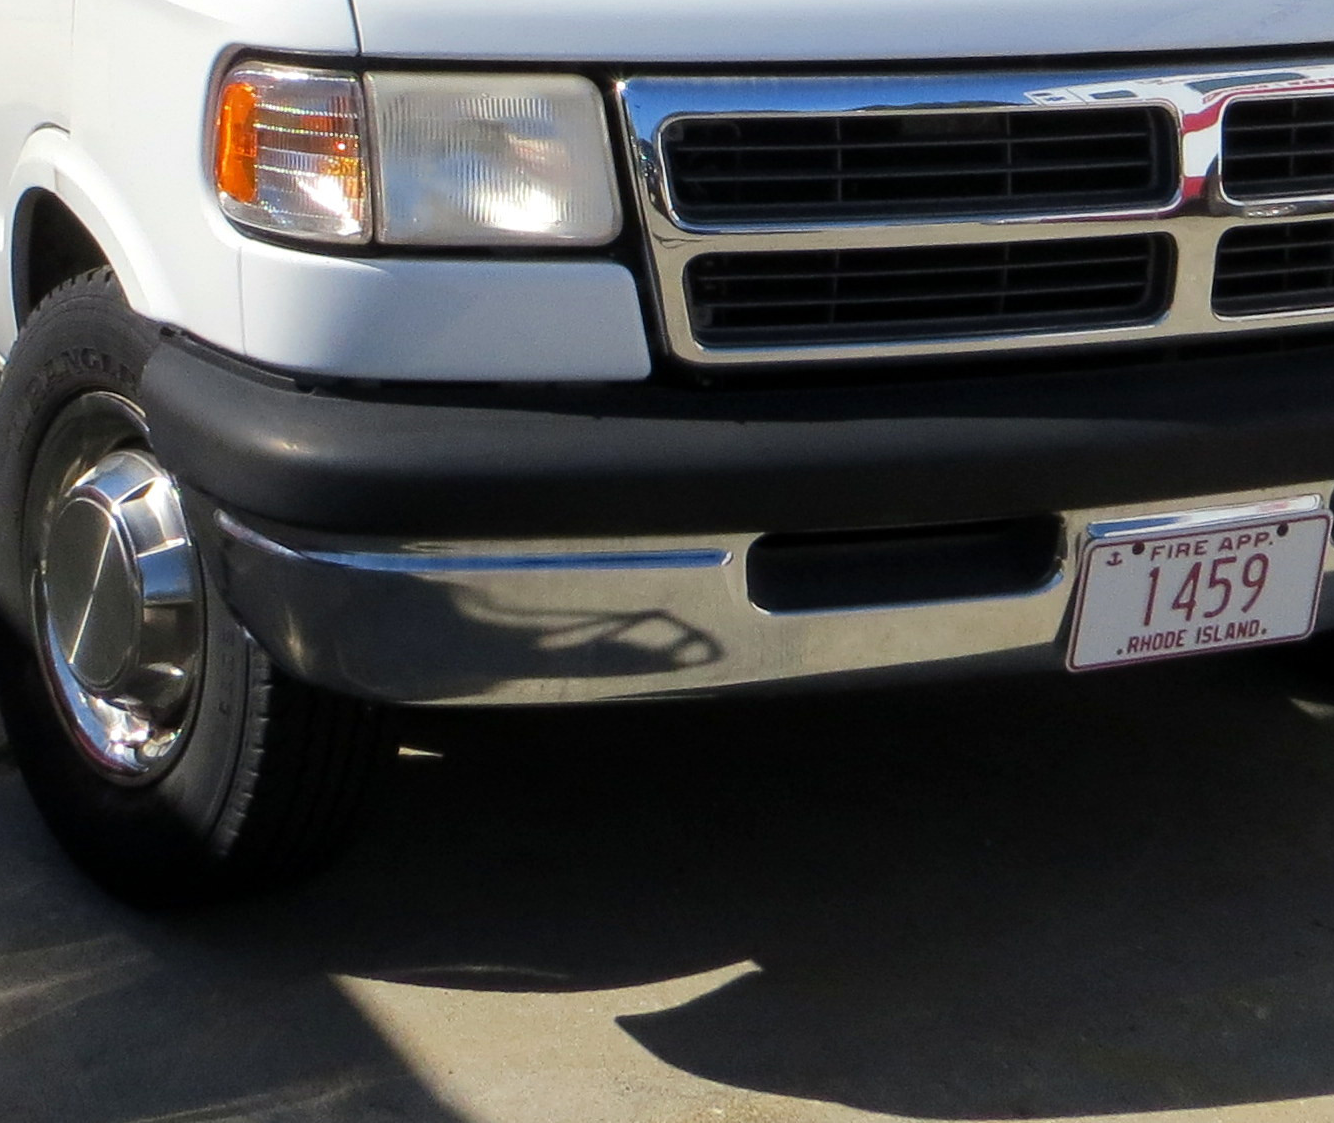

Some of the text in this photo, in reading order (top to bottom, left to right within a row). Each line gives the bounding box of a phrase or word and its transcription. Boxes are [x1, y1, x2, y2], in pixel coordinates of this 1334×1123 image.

[1150, 531, 1274, 562] FIRE APP.
[1142, 552, 1270, 627] 1459
[1126, 629, 1188, 655] RHODE
